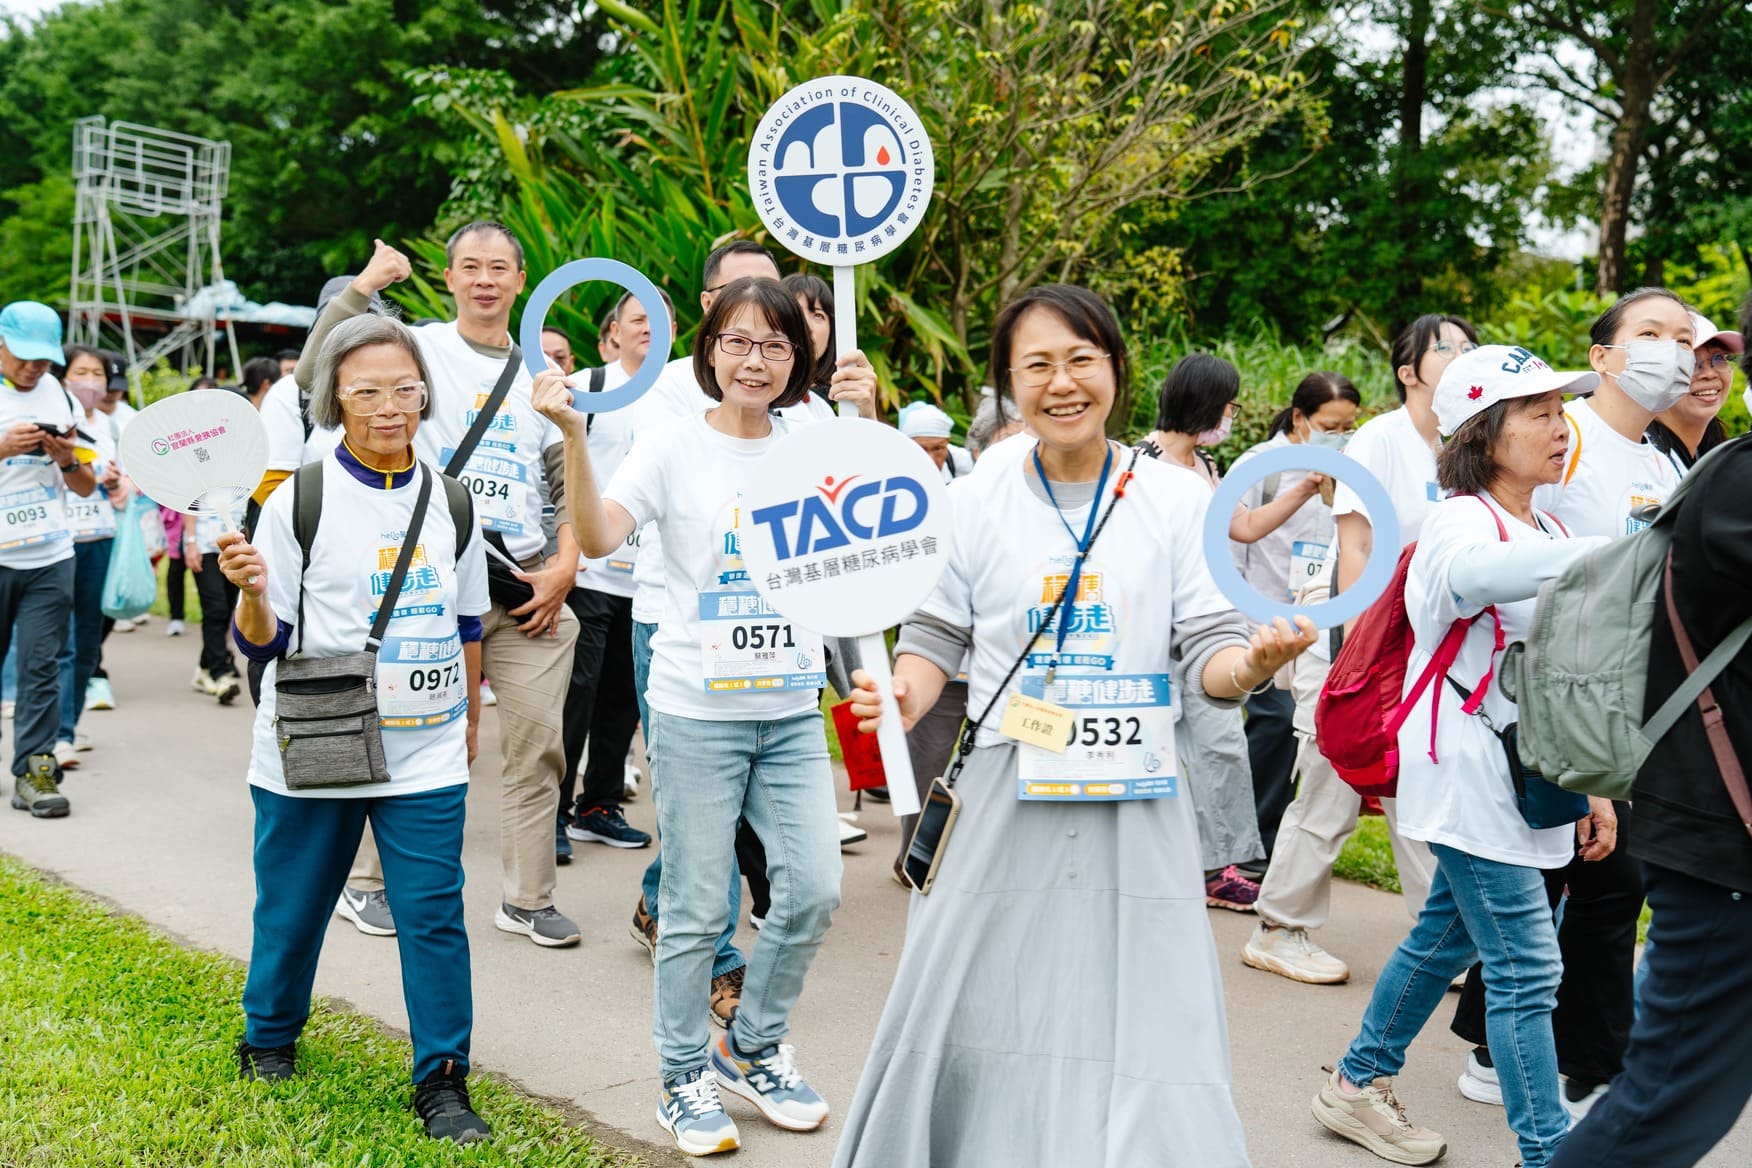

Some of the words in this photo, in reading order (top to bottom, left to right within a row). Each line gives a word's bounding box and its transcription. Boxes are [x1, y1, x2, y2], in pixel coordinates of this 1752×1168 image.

[840, 86, 857, 97] of
[863, 91, 913, 135] Clinical
[760, 88, 833, 152] Association
[758, 158, 776, 216] Taiwan
[907, 139, 926, 211] Diabetes
[772, 212, 911, 255] 台灣基層糖尿病學會
[6, 506, 47, 525] 0093
[751, 475, 929, 561] TACD
[765, 535, 939, 591] 台灣基層糖尿病學會
[732, 624, 796, 650] 0571
[409, 661, 460, 692] 0972
